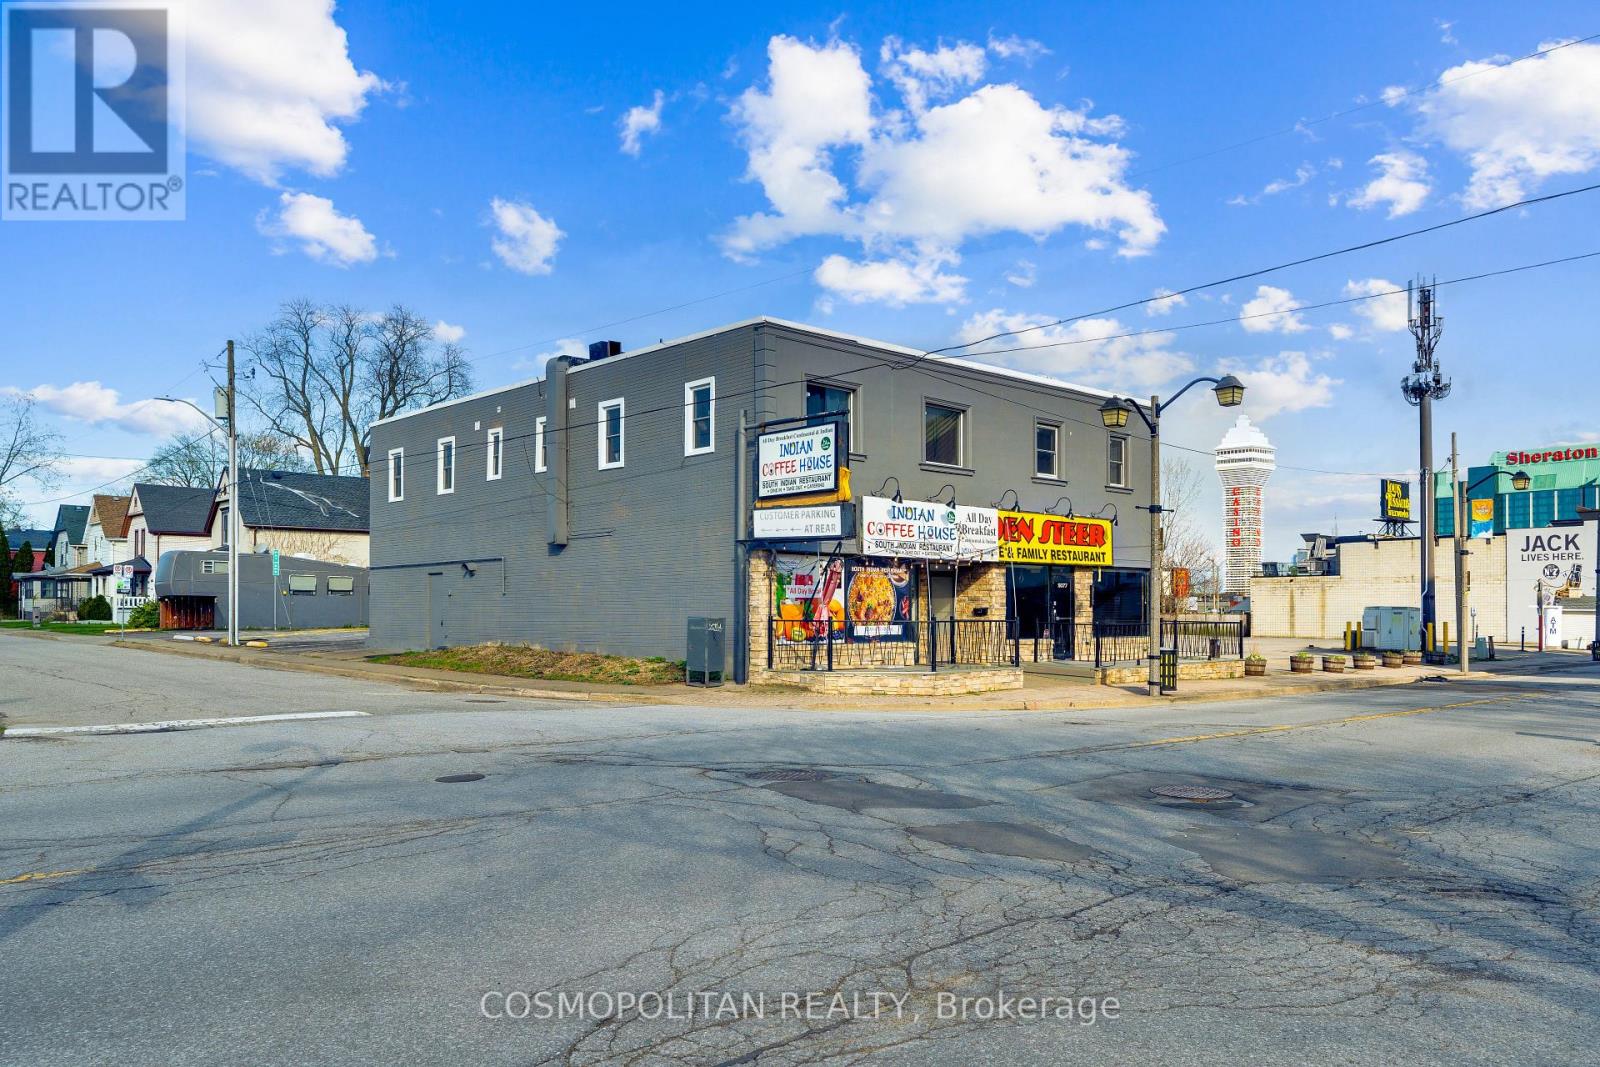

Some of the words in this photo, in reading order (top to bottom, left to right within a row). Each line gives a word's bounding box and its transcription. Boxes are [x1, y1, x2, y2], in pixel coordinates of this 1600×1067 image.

[780, 439, 813, 457] INDIAN
[1506, 447, 1598, 465] Sheraton
[762, 460, 797, 477] COFFEE
[800, 455, 832, 472] HOUSE
[762, 480, 778, 489] SOUTH
[781, 478, 797, 486] INDIAN
[799, 474, 831, 484] RESTAURANT
[760, 510, 799, 520] CUSTOMER
[801, 509, 836, 519] PARKING
[891, 505, 934, 522] INDIAN
[966, 512, 976, 523] All
[978, 512, 992, 525] Day
[1232, 487, 1241, 547] CASINO
[804, 524, 813, 533] AT
[815, 523, 836, 533] REAR
[867, 521, 915, 538] COFFEE
[918, 525, 957, 540] HOUSE
[962, 523, 996, 537] Breakfast
[1038, 519, 1106, 548] STEER
[875, 540, 894, 549] SOUTH
[919, 542, 953, 553] RESTAURANT
[1521, 533, 1581, 552] JACK
[1017, 547, 1049, 560] FAMILY
[1050, 549, 1106, 562] RESTAURANT
[1521, 553, 1549, 561] LIVES
[1552, 552, 1584, 561] HERE.
